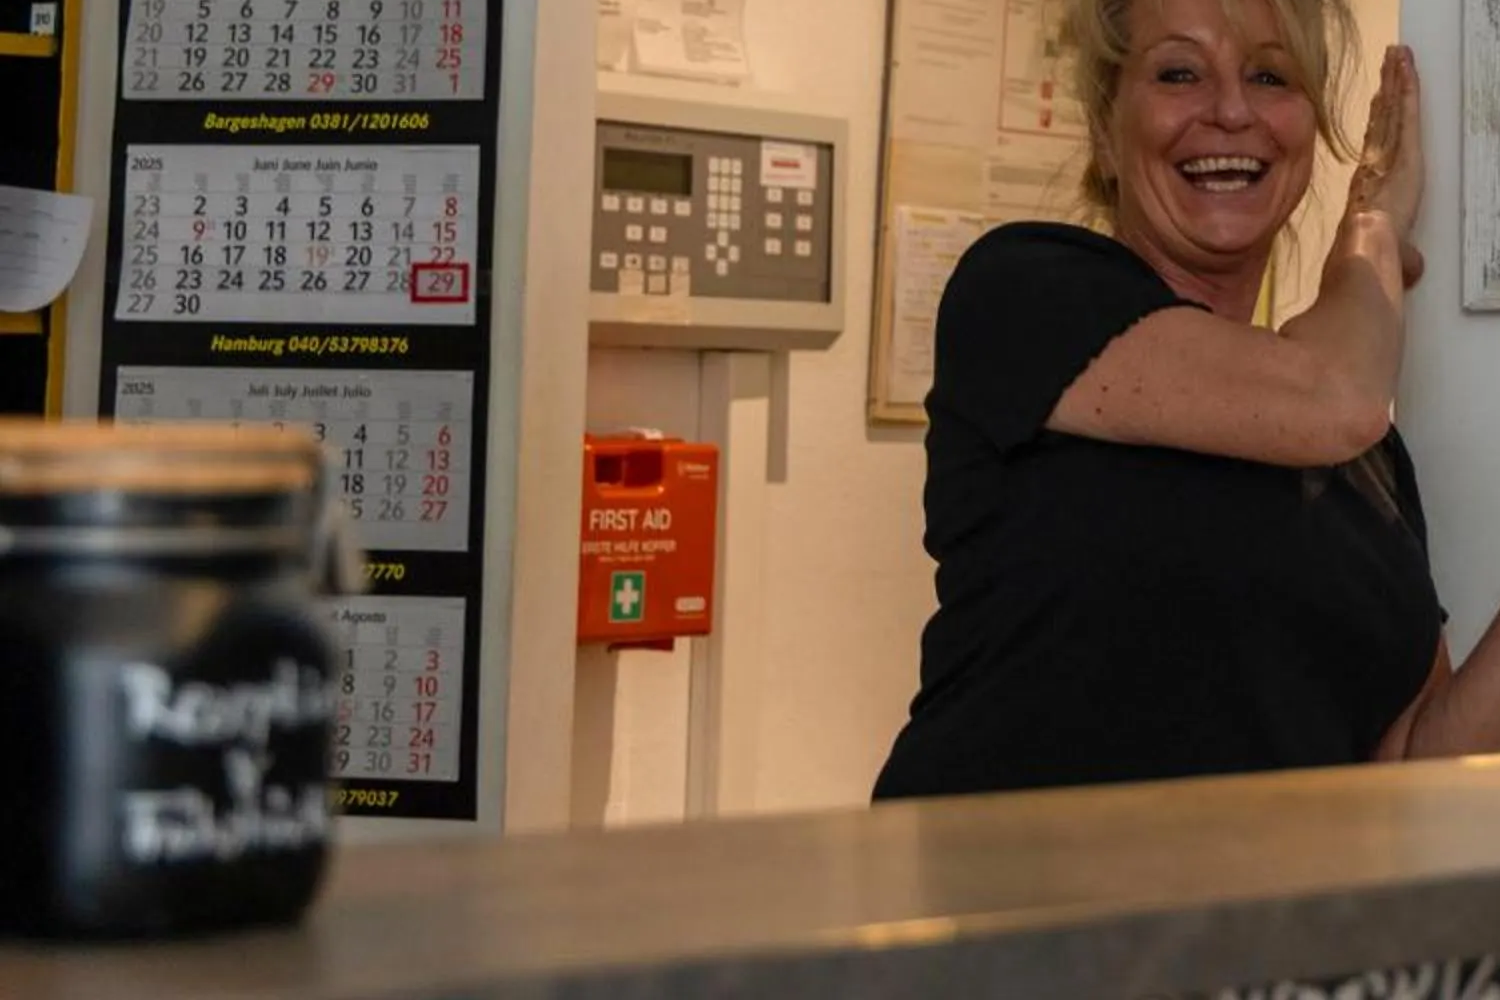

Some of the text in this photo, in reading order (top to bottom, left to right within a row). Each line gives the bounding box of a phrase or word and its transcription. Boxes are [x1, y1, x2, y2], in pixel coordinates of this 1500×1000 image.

[142, 0, 166, 18] 19
[284, 0, 298, 18] 7
[326, 0, 340, 20] 8
[370, 0, 383, 20] 9
[400, 0, 424, 20] 10
[442, 0, 462, 18] 11
[136, 24, 463, 44] 20 12 13 14 15 16 17 18
[134, 48, 462, 70] 21 19 20 21 22 23 24 25
[132, 72, 460, 94] 22 26 27 28 29 30 31 1
[204, 112, 429, 133] Bargeshagen 0381/1201606
[132, 157, 163, 171] 2025
[134, 194, 458, 217] 23 2 3 4 5 6 7 8
[134, 220, 456, 242] 24 9 10 11 12 13 14 15
[132, 246, 456, 267] 25 16 17 18 19 20 21 22
[130, 270, 454, 292] 26 23 24 25 26 27 28 29
[128, 294, 200, 314] 27 30
[211, 334, 409, 356] Hamburg 040/53798376
[122, 382, 155, 395] 2025
[314, 422, 451, 446] 3 4 5 6
[344, 450, 450, 470] 11 12 13
[340, 474, 448, 496] 18 19 20
[378, 500, 404, 520] 26
[420, 500, 448, 522] 27
[589, 508, 673, 532] FIRST AID
[363, 563, 405, 580] 7770
[340, 609, 387, 626] Agosto
[346, 648, 440, 672] 1 2 3
[342, 674, 438, 696] 8 9 10
[372, 702, 394, 722] 16
[412, 702, 436, 722] 17
[366, 726, 392, 747] 23
[408, 728, 434, 748] 24
[366, 752, 392, 772] 30
[406, 752, 431, 774] 31
[336, 789, 399, 808] 979037
